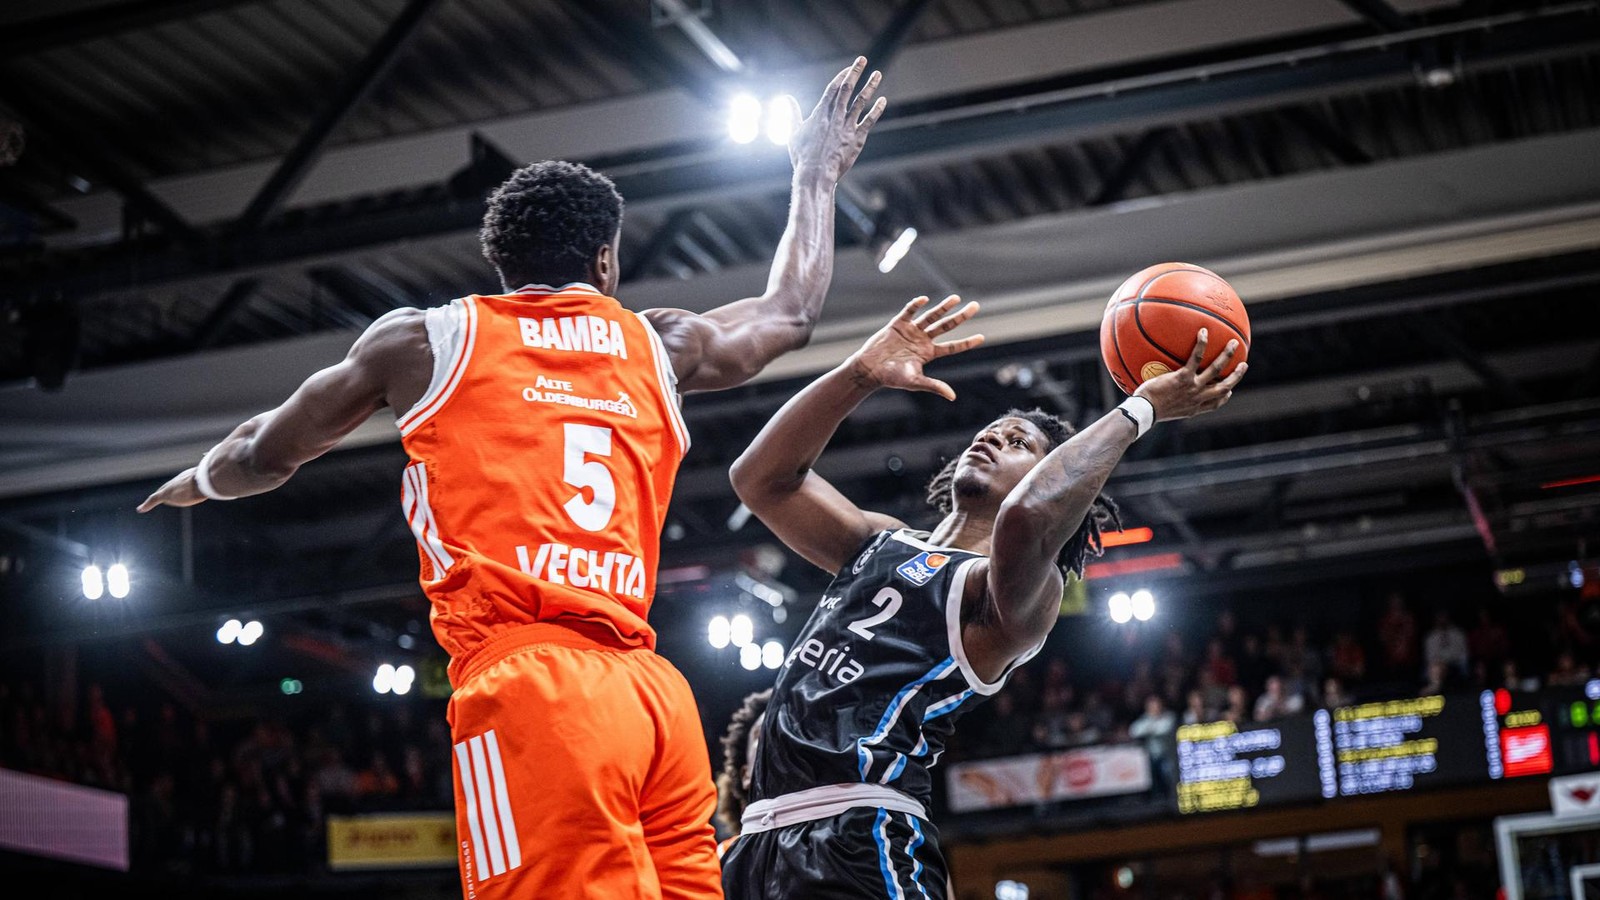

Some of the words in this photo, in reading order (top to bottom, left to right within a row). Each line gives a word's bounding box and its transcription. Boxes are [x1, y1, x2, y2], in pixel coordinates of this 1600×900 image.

[517, 315, 628, 360] BAMBA
[562, 422, 616, 532] 5
[516, 542, 646, 599] VECHTA
[902, 566, 927, 583] BBL
[847, 586, 903, 641] 2
